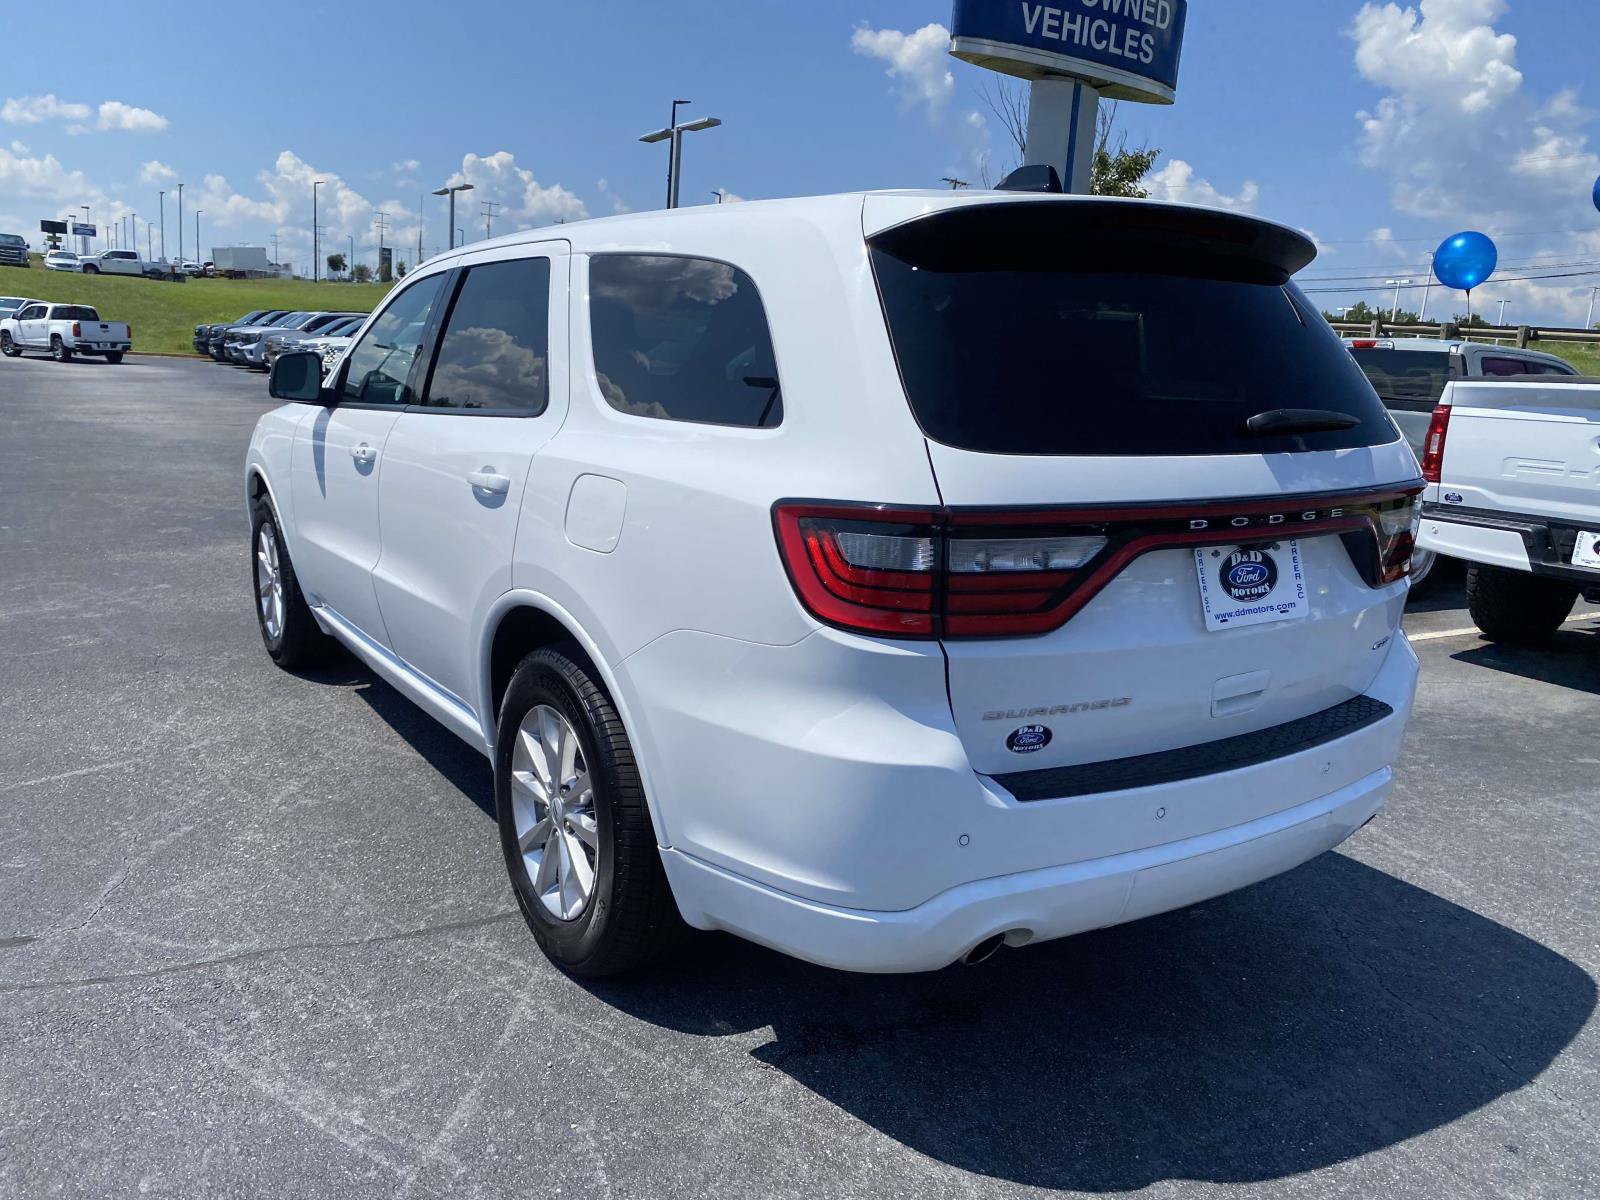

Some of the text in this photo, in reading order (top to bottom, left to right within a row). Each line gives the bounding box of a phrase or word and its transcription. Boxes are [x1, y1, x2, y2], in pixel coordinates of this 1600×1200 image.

[1082, 0, 1171, 30] NED
[1022, 2, 1155, 64] VEHICLES
[1190, 509, 1343, 529] DODGE
[1230, 549, 1263, 567] D&D
[1289, 538, 1304, 599] GREER SC
[1196, 549, 1211, 613] GREER SC
[1236, 566, 1261, 583] Ford
[1231, 581, 1270, 598] MOTORS
[1214, 602, 1296, 620] www.ddmotors.com
[982, 696, 1133, 721] DURANGO
